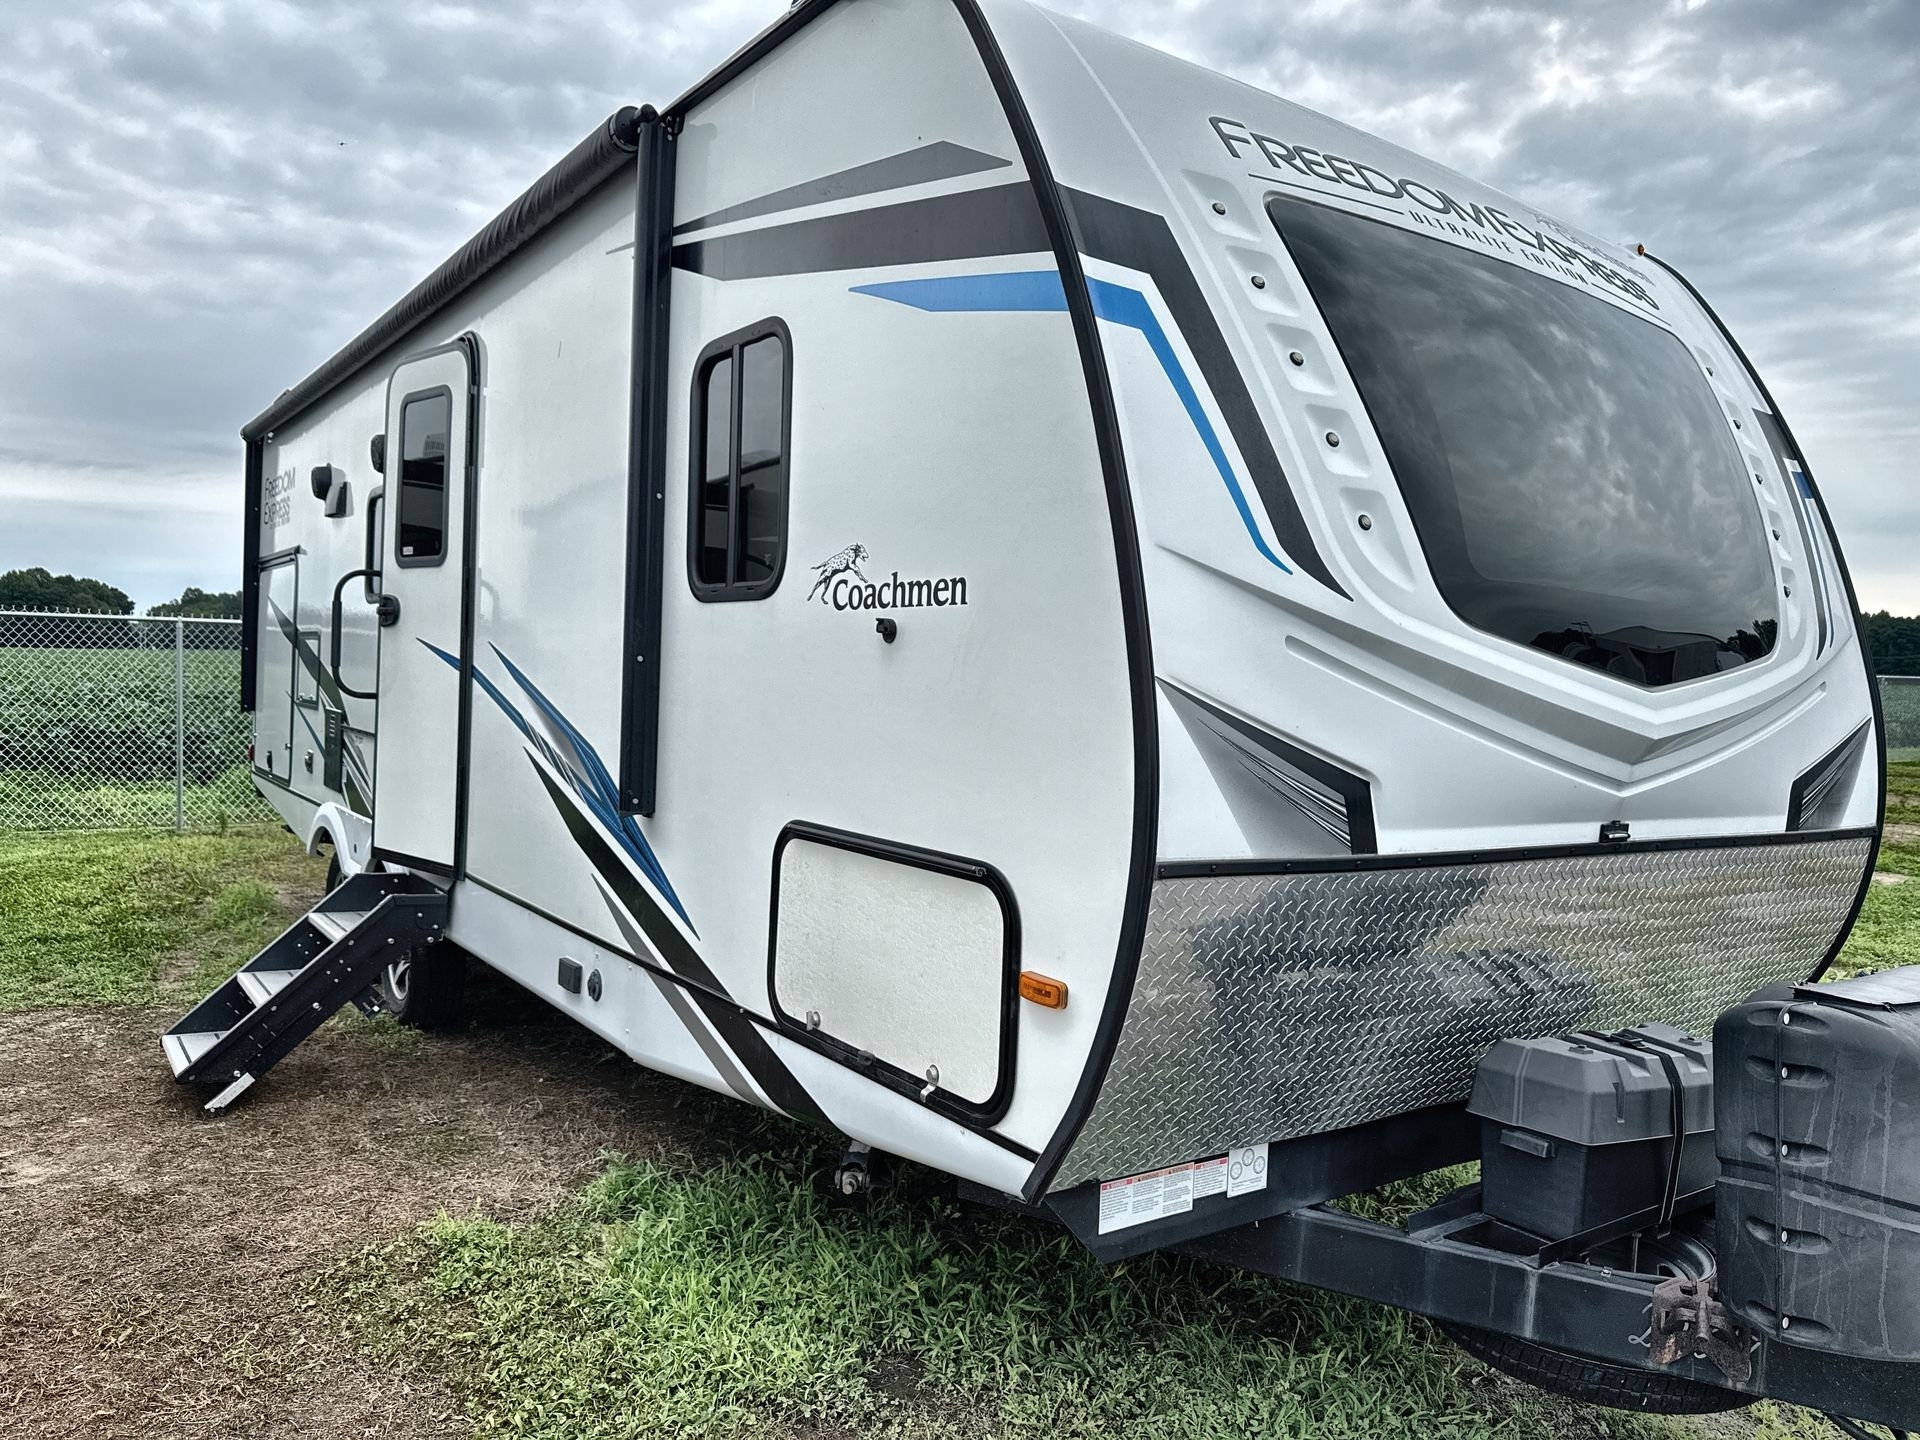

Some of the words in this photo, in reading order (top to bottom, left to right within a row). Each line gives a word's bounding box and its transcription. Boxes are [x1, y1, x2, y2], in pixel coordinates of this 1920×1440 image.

[1520, 248, 1588, 285] EDITION
[264, 467, 296, 501] FREEDOM
[263, 496, 290, 525] EXPRESS
[832, 571, 968, 611] Coachmen
